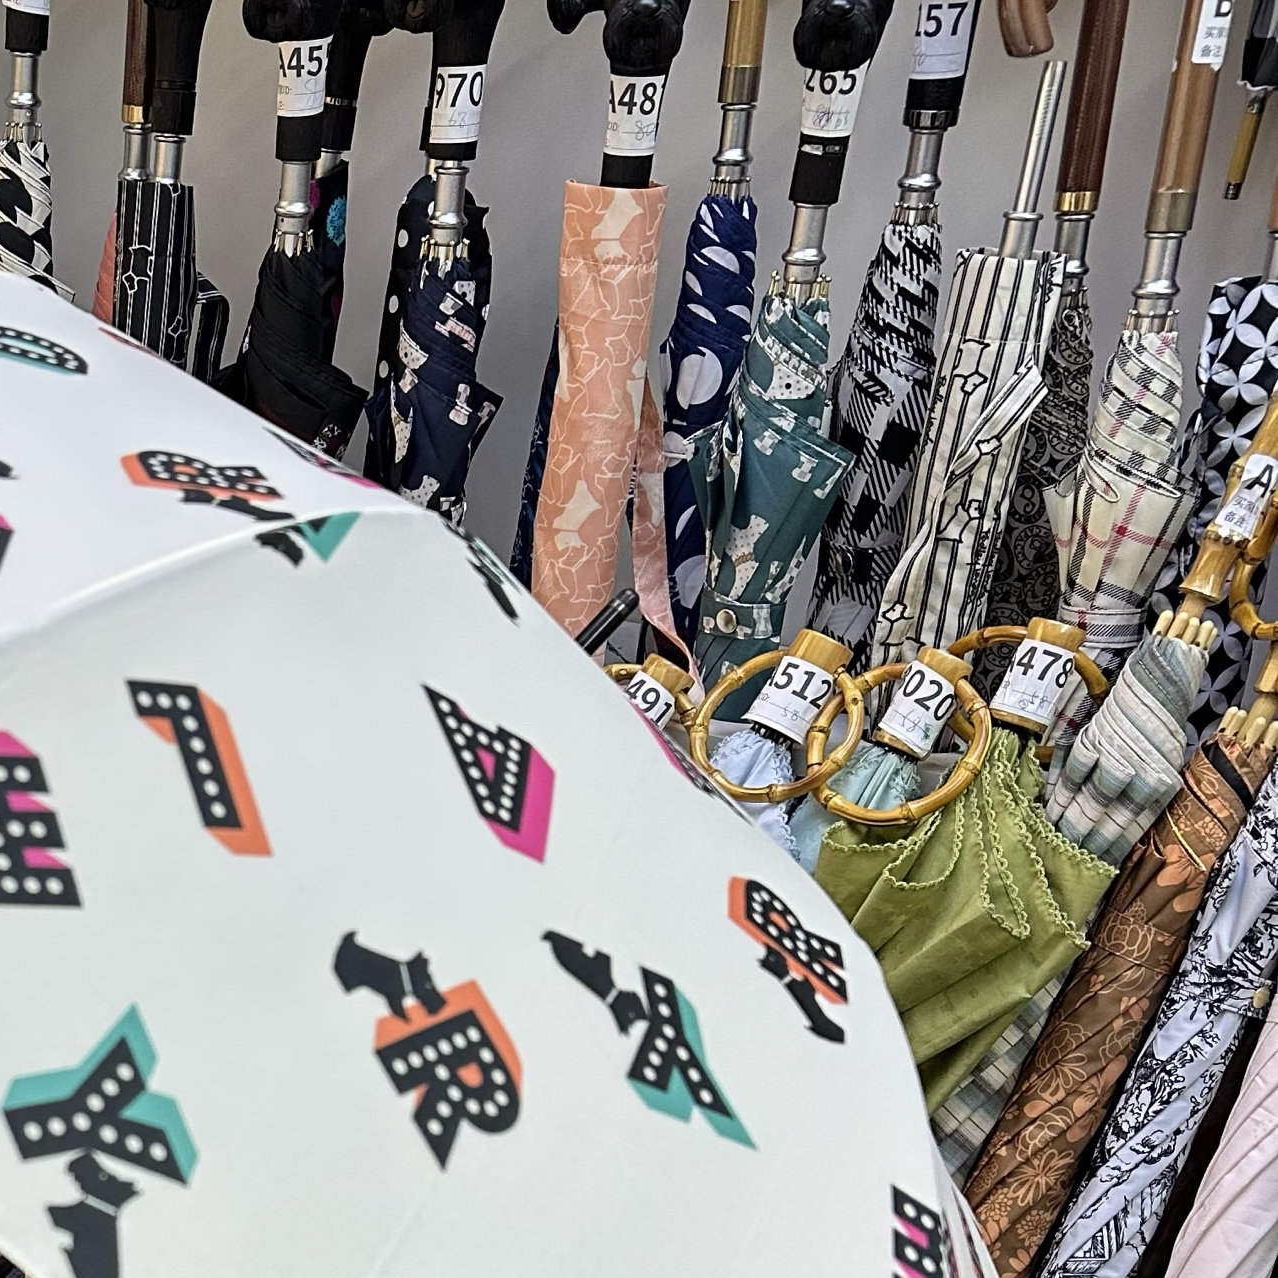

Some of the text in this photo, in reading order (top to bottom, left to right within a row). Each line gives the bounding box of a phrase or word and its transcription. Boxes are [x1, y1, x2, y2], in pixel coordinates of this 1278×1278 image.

[279, 44, 331, 77] A45
[609, 80, 663, 115] A48
[1245, 464, 1275, 499] A
[766, 661, 833, 710] 512
[904, 664, 955, 721] 020
[1010, 645, 1075, 689] 478
[624, 678, 673, 727] 491
[420, 682, 556, 865] A
[727, 875, 849, 1005] R
[372, 978, 523, 1172] R
[627, 965, 759, 1151] Y
[0, 1000, 199, 1187] Y
